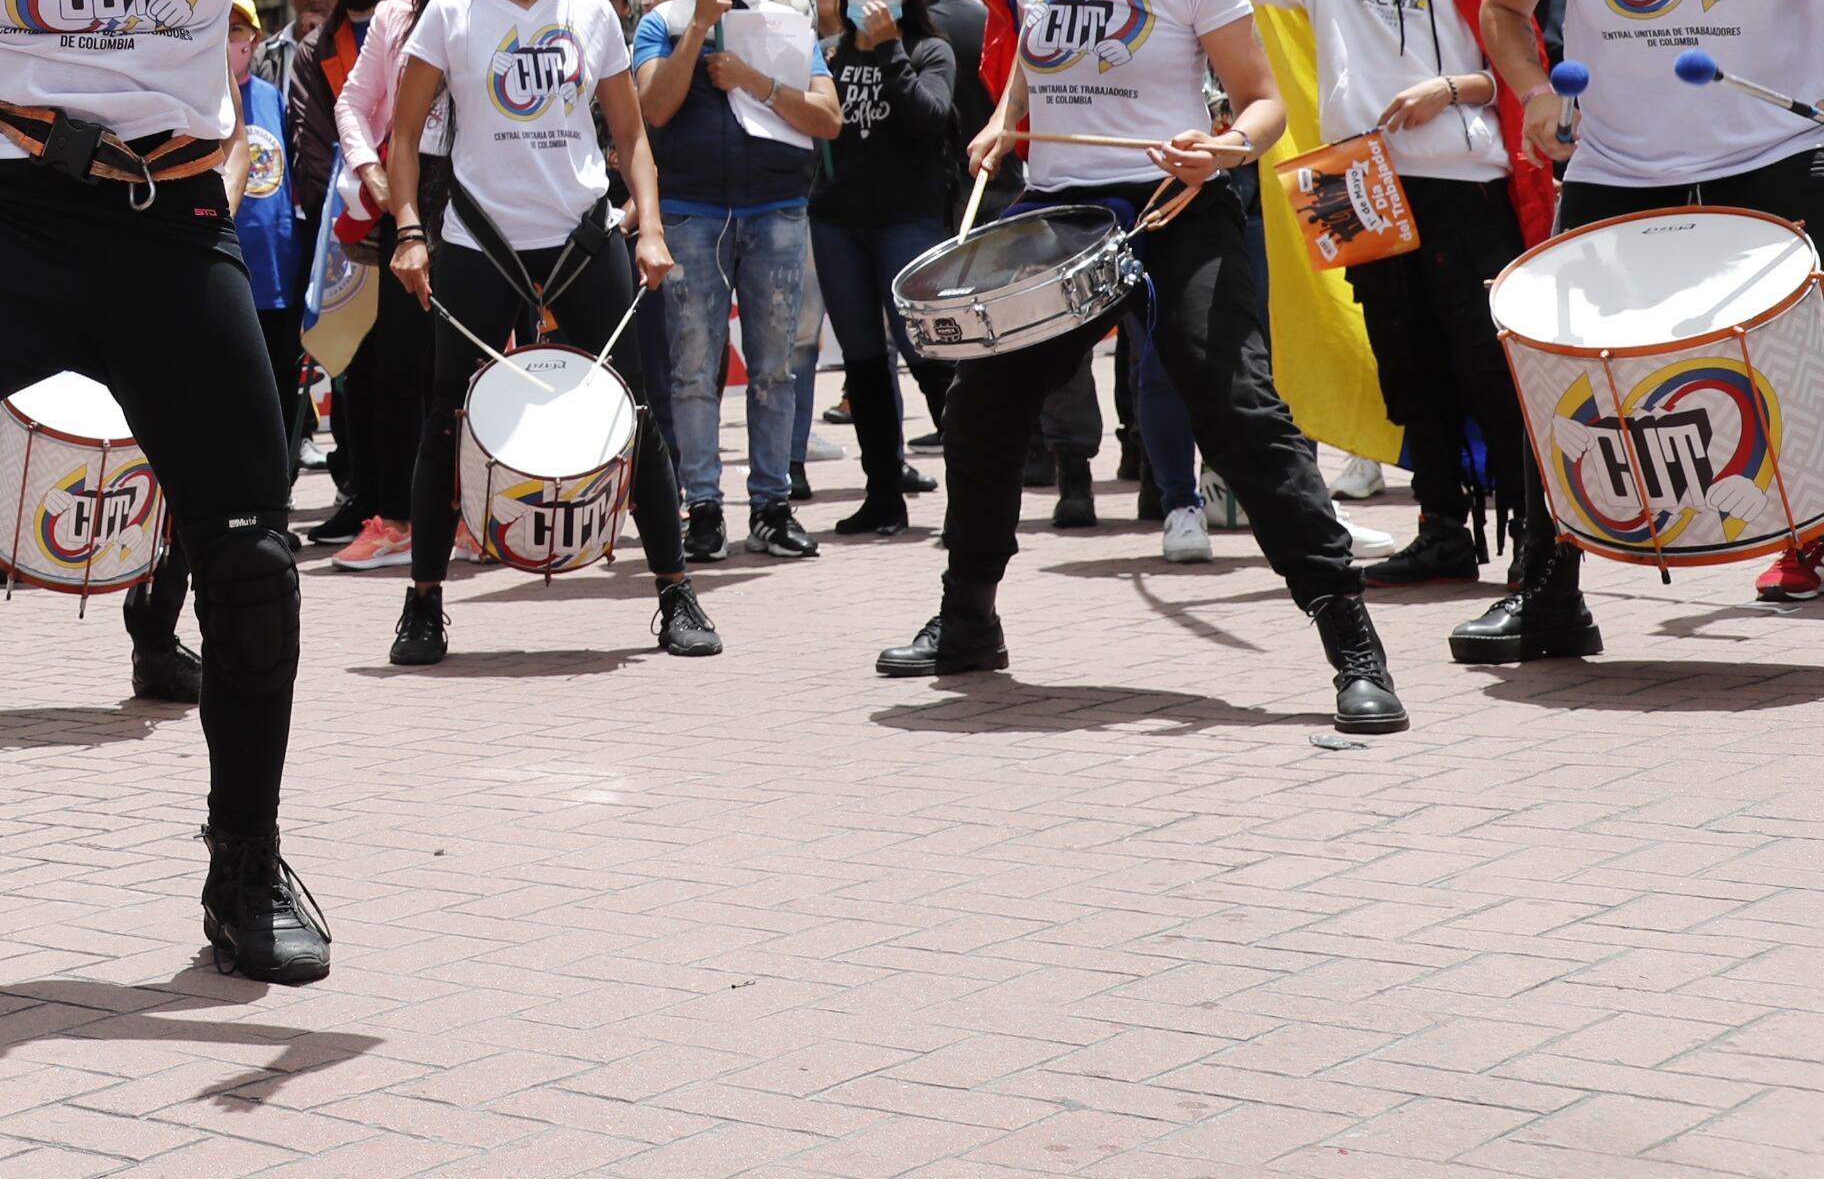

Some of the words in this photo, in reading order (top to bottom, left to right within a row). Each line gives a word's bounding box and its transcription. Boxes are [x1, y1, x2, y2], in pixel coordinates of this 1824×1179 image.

[1037, 0, 1110, 52] CUT
[1634, 29, 1671, 39] UNITARIA
[1672, 27, 1683, 36] DE
[1685, 26, 1741, 37] TRABAJADORES
[60, 35, 74, 48] DE
[78, 35, 135, 50] COLOMBIA
[1647, 38, 1658, 48] DE
[1659, 37, 1699, 48] COLOMBIA
[510, 49, 564, 97] CUT
[846, 84, 884, 102] DAY
[1038, 84, 1068, 94] UNITARIA
[1069, 84, 1078, 94] DE
[1080, 86, 1139, 99] TRABAJADORES
[1046, 96, 1054, 104] DE
[1055, 95, 1093, 104] COLOMBIA
[494, 132, 521, 141] CENTRAL
[548, 131, 556, 139] DE
[538, 140, 567, 149] COLOMBIA
[1351, 171, 1363, 199] Mayo
[1368, 140, 1405, 218] Trabajador
[1360, 201, 1370, 215] de
[1396, 219, 1413, 242] del
[1587, 412, 1711, 508] CUT
[67, 489, 134, 543] CUT
[523, 499, 609, 554] CUT
